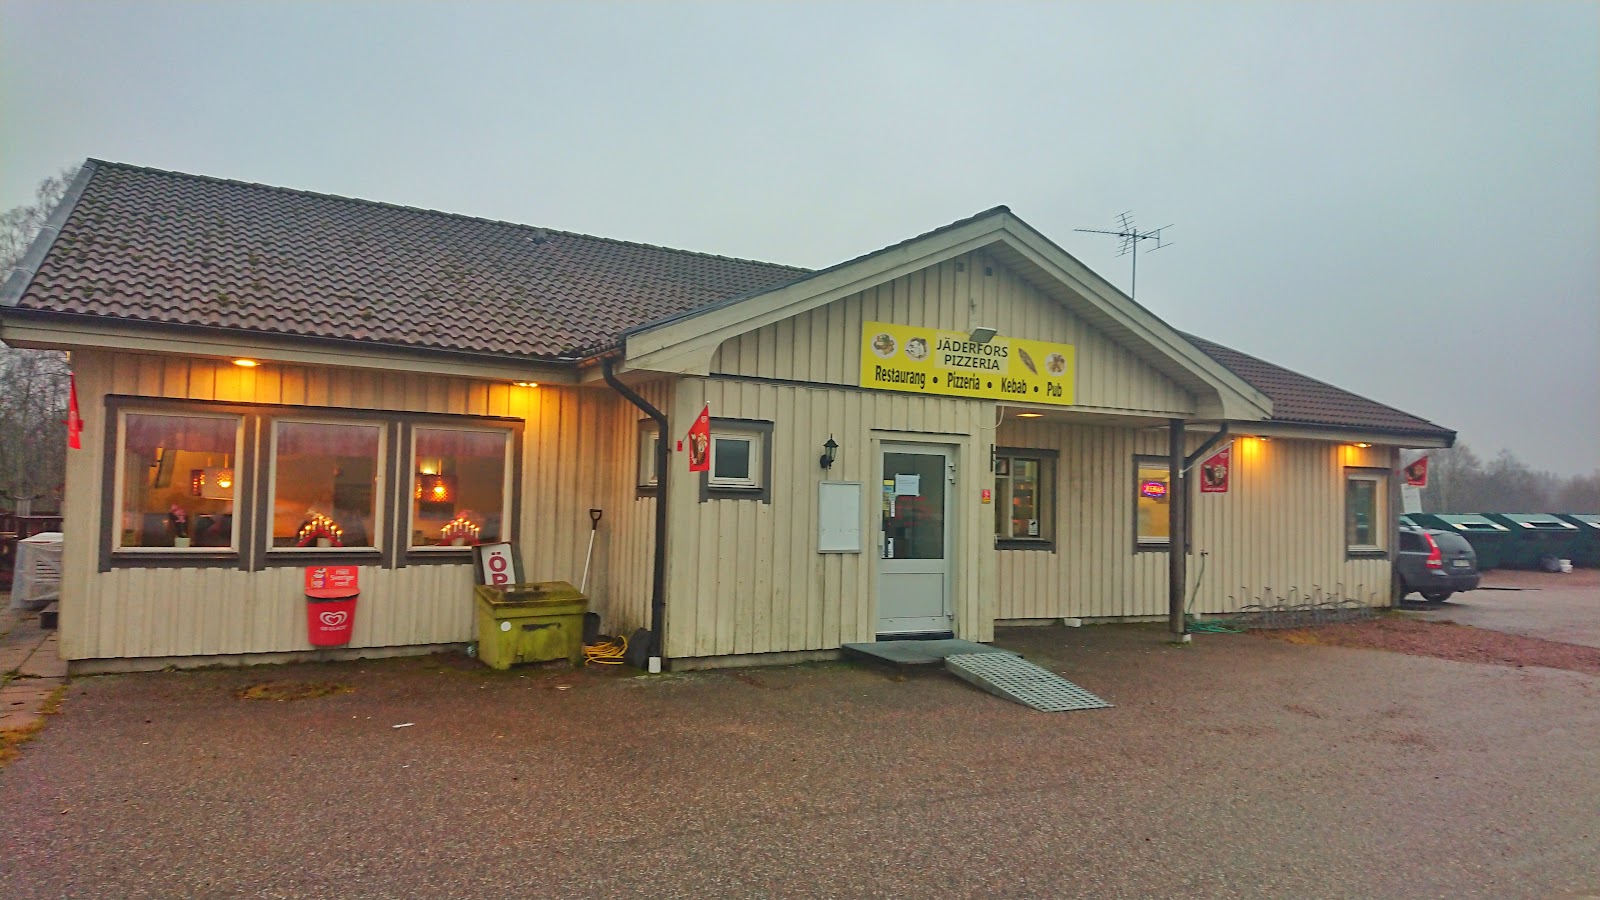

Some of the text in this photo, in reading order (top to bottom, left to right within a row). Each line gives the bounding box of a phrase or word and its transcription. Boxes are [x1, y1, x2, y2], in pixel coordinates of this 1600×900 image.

[936, 337, 1008, 357] JÄDERFORS
[944, 354, 1000, 371] PIZZERIA
[875, 365, 1063, 398] Restaurang Pizzeria Kebab Pub
